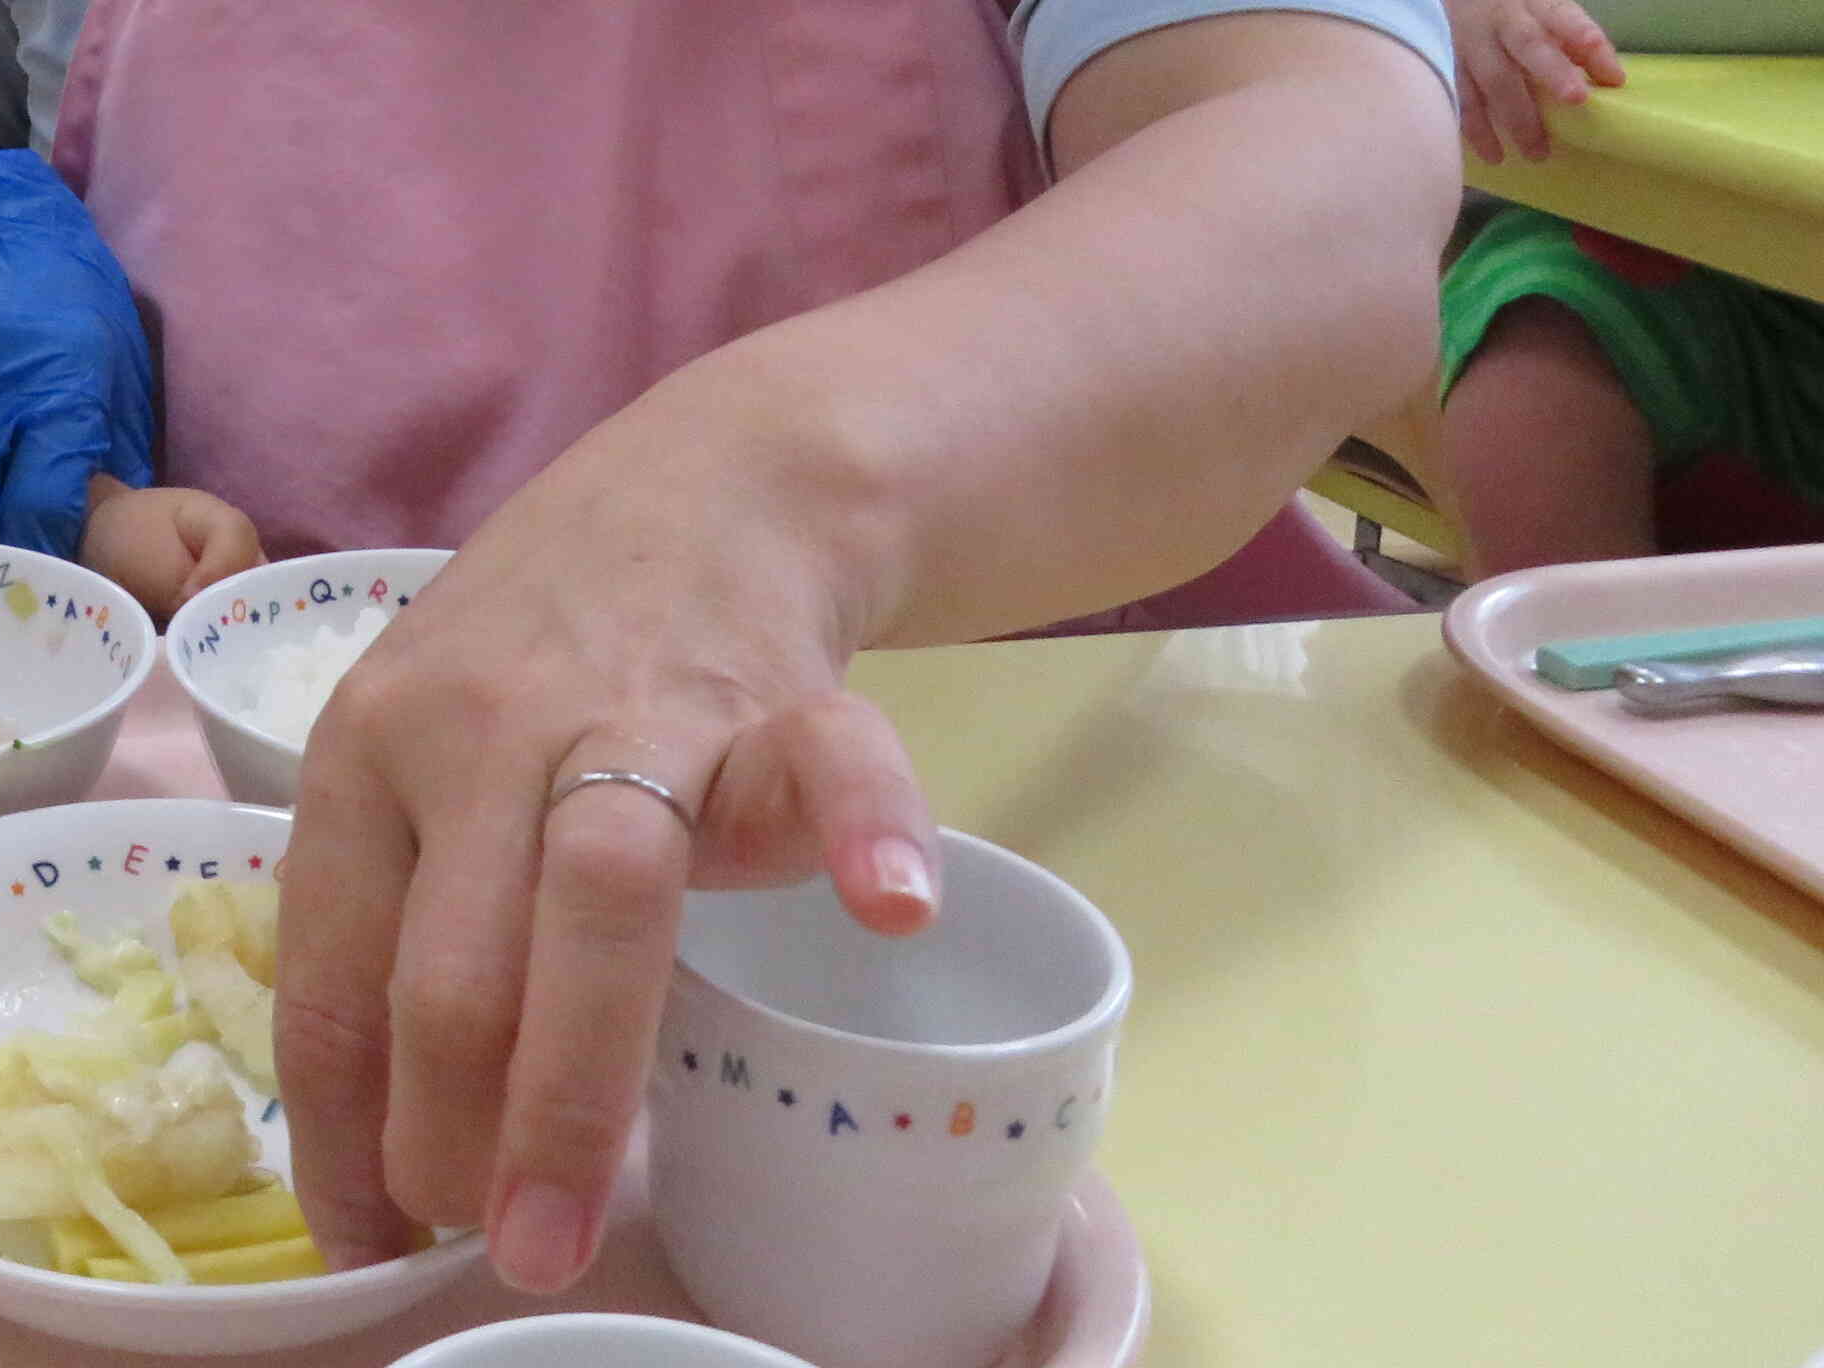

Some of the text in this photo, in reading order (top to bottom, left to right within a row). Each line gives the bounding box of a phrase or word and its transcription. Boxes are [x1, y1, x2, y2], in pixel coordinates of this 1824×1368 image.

[63, 598, 79, 620] A
[204, 623, 221, 656] N
[309, 578, 337, 604] Q
[368, 577, 389, 604] R
[32, 860, 60, 888] D
[123, 843, 150, 876] E
[719, 1052, 751, 1092] M
[828, 1100, 860, 1136] A
[948, 1101, 977, 1138] B
